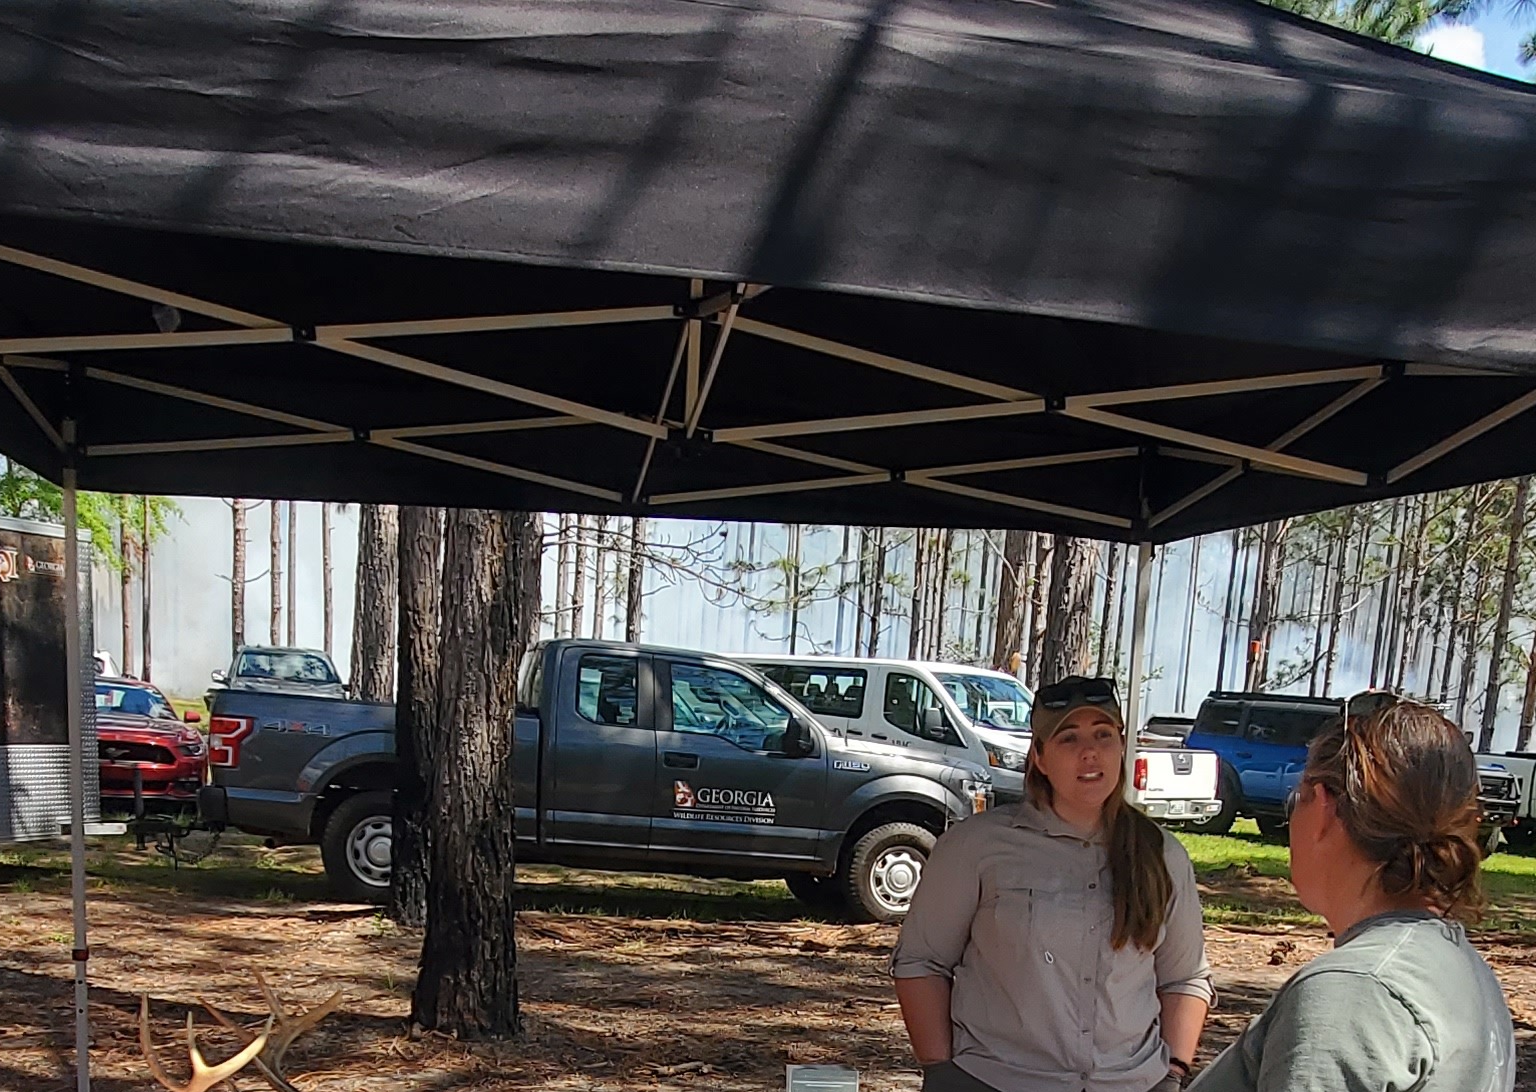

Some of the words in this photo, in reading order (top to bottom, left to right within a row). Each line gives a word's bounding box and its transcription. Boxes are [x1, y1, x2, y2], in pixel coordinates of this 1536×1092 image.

[697, 788, 775, 807] GEORGIA
[673, 811, 704, 820] WILDLIFE
[705, 813, 743, 823] RESOURCES
[744, 815, 775, 824] DIVISION
